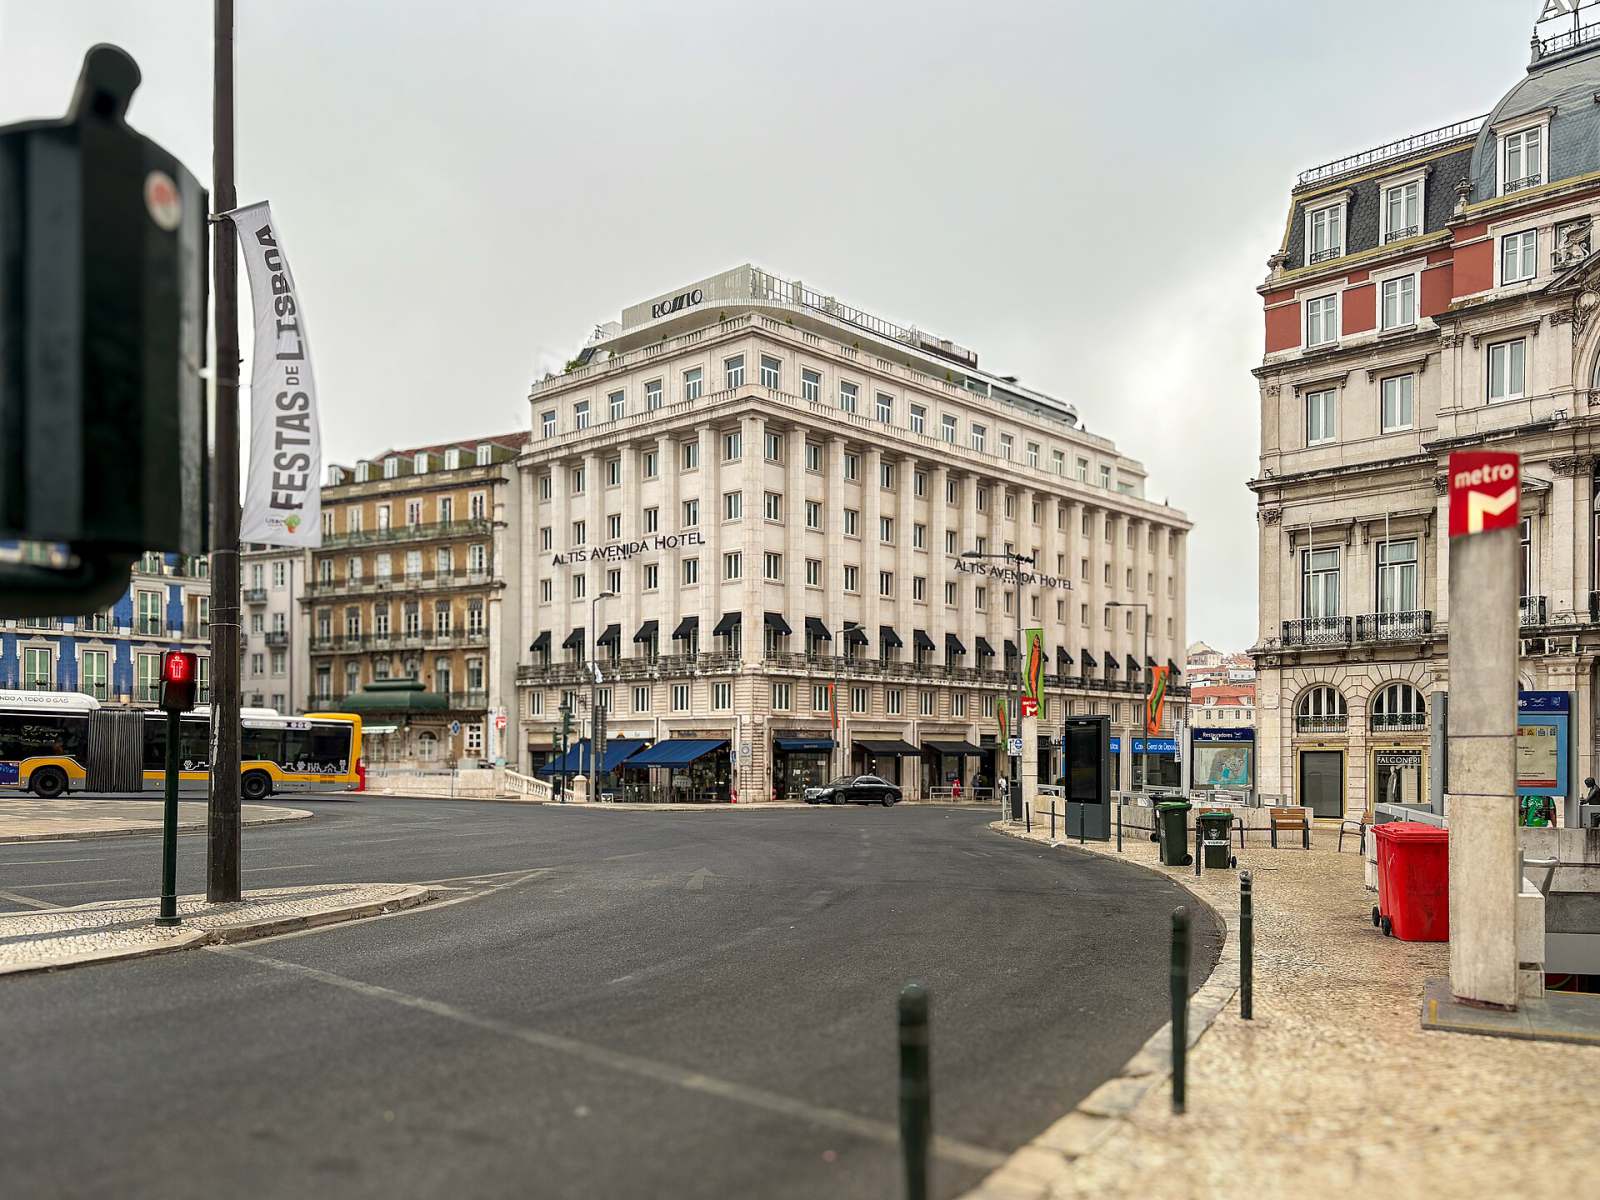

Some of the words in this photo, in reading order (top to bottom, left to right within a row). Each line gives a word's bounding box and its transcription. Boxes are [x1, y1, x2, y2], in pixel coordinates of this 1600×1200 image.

[255, 223, 305, 361] LISBOA
[286, 365, 300, 386] DE
[269, 390, 311, 511] FESTAS
[1454, 463, 1515, 489] metro
[552, 550, 587, 566] ALTIS
[590, 540, 650, 561] AVENIDA
[654, 532, 706, 550] HOTEL
[954, 560, 986, 575] ALTIS
[989, 566, 1036, 584] AVENDA
[1040, 575, 1074, 591] HOTEL
[1376, 756, 1420, 764] FALCONERI
